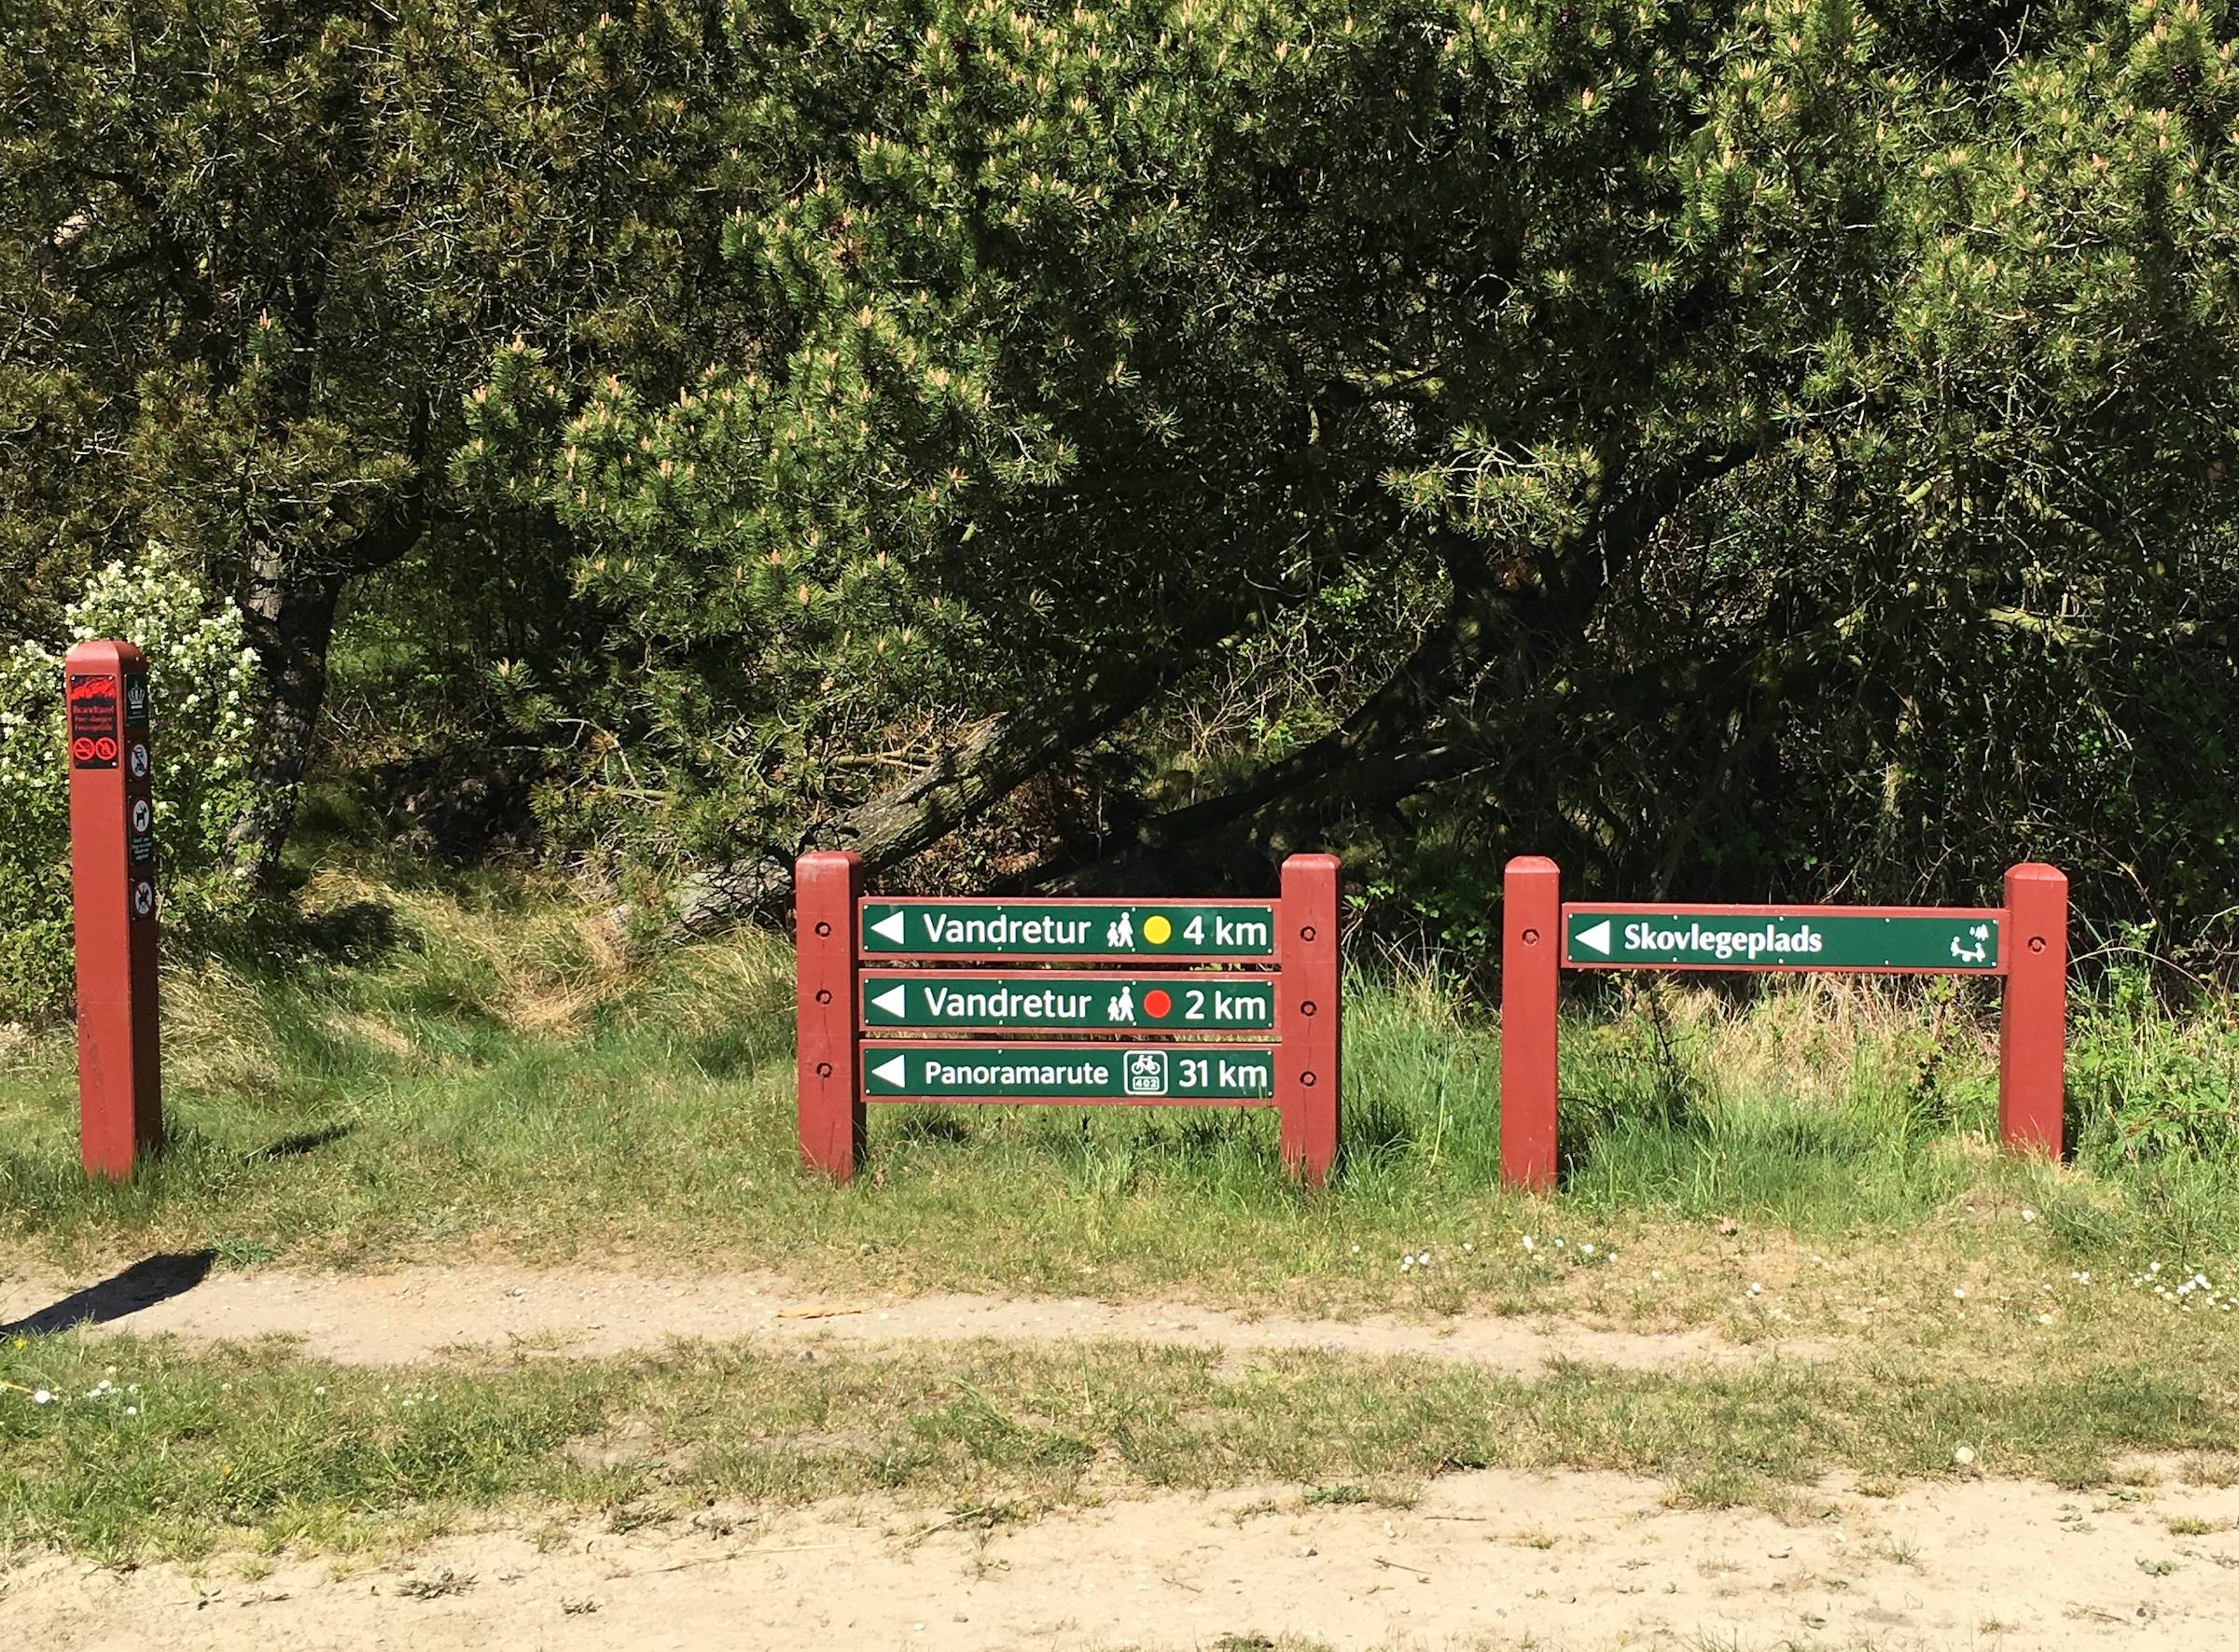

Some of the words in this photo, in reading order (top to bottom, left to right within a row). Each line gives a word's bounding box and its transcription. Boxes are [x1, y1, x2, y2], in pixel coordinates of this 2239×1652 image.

[923, 913, 1092, 944] Vandretur
[1183, 915, 1205, 945] 4
[1216, 915, 1267, 946] km
[1623, 922, 1823, 960] Skovlegeplads
[924, 987, 1093, 1018] Vandretur
[1185, 989, 1205, 1020] 2
[1215, 990, 1266, 1020] km
[925, 1061, 1109, 1085] Panoramarute
[1178, 1059, 1208, 1088] 31
[1218, 1059, 1267, 1088] km
[1135, 1078, 1157, 1089] 402
